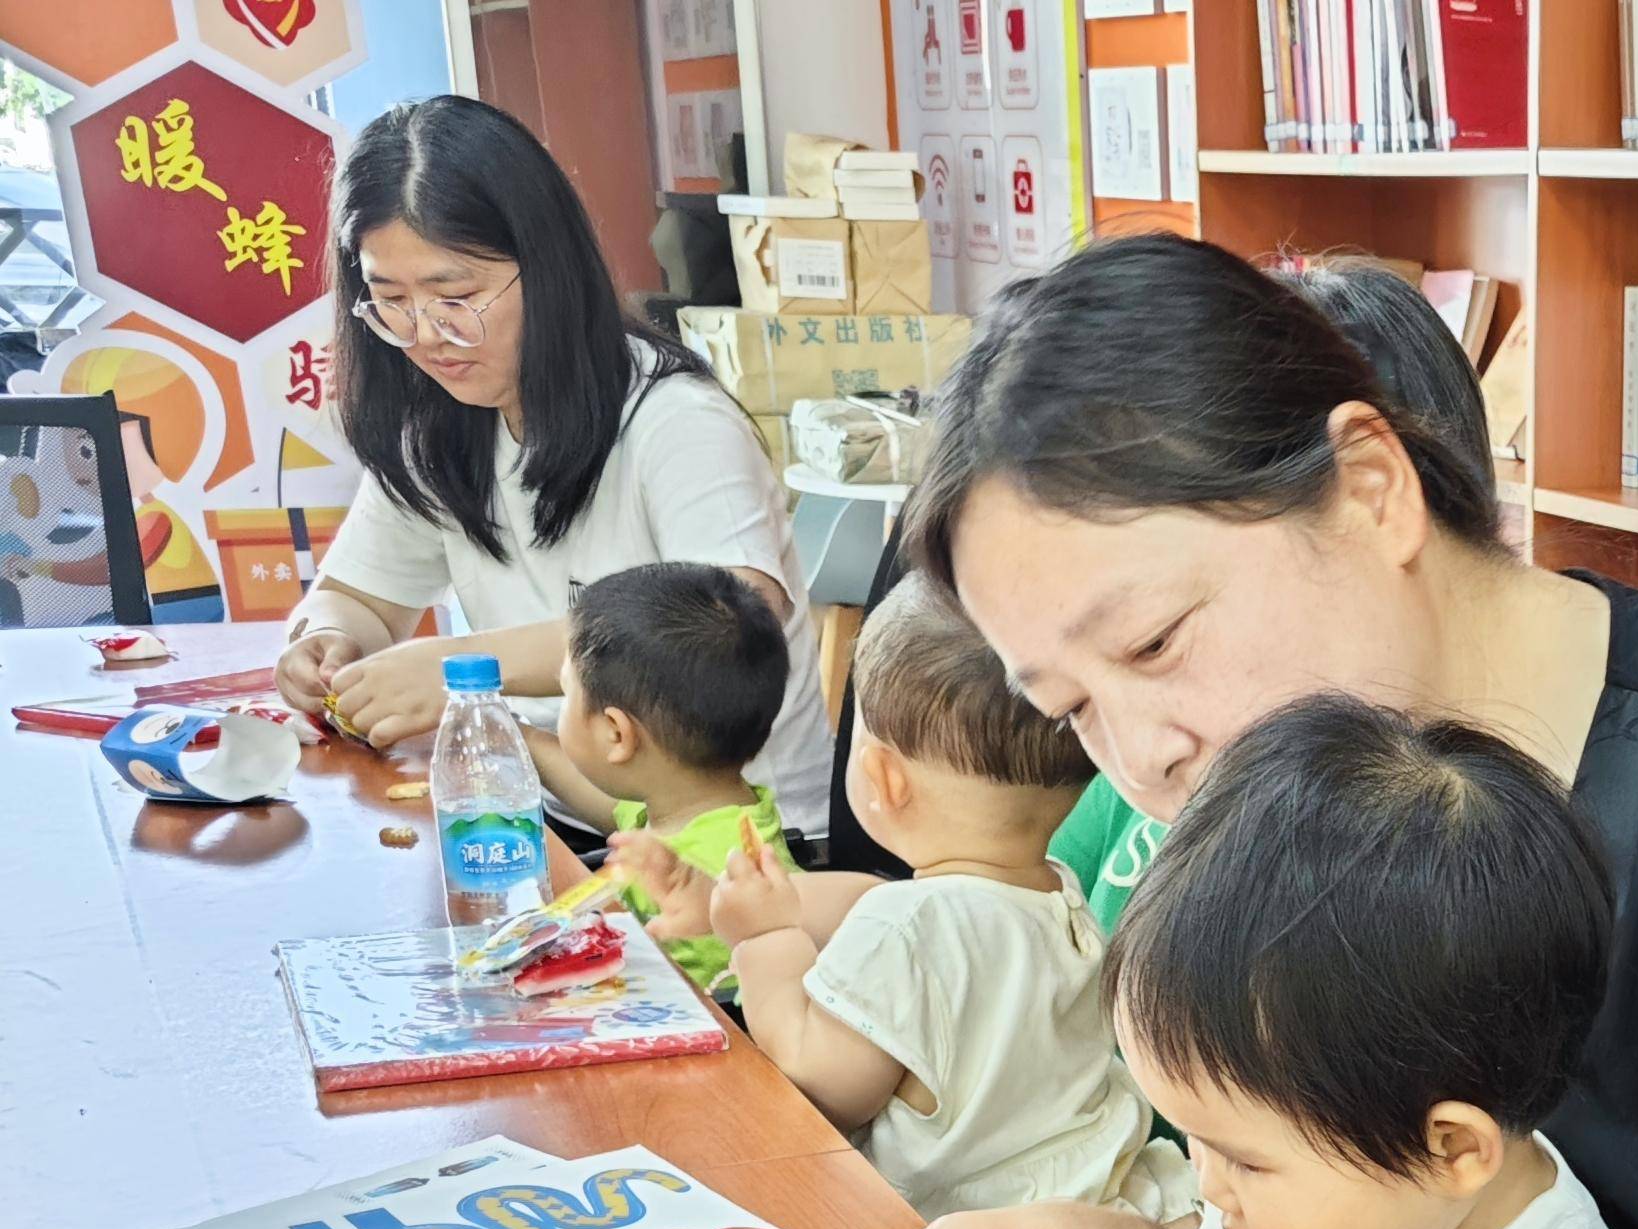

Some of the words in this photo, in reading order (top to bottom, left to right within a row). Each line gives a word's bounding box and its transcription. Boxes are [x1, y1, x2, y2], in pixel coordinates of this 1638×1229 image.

[767, 316, 925, 346] 外文出版社
[460, 841, 533, 864] 洞庭山
